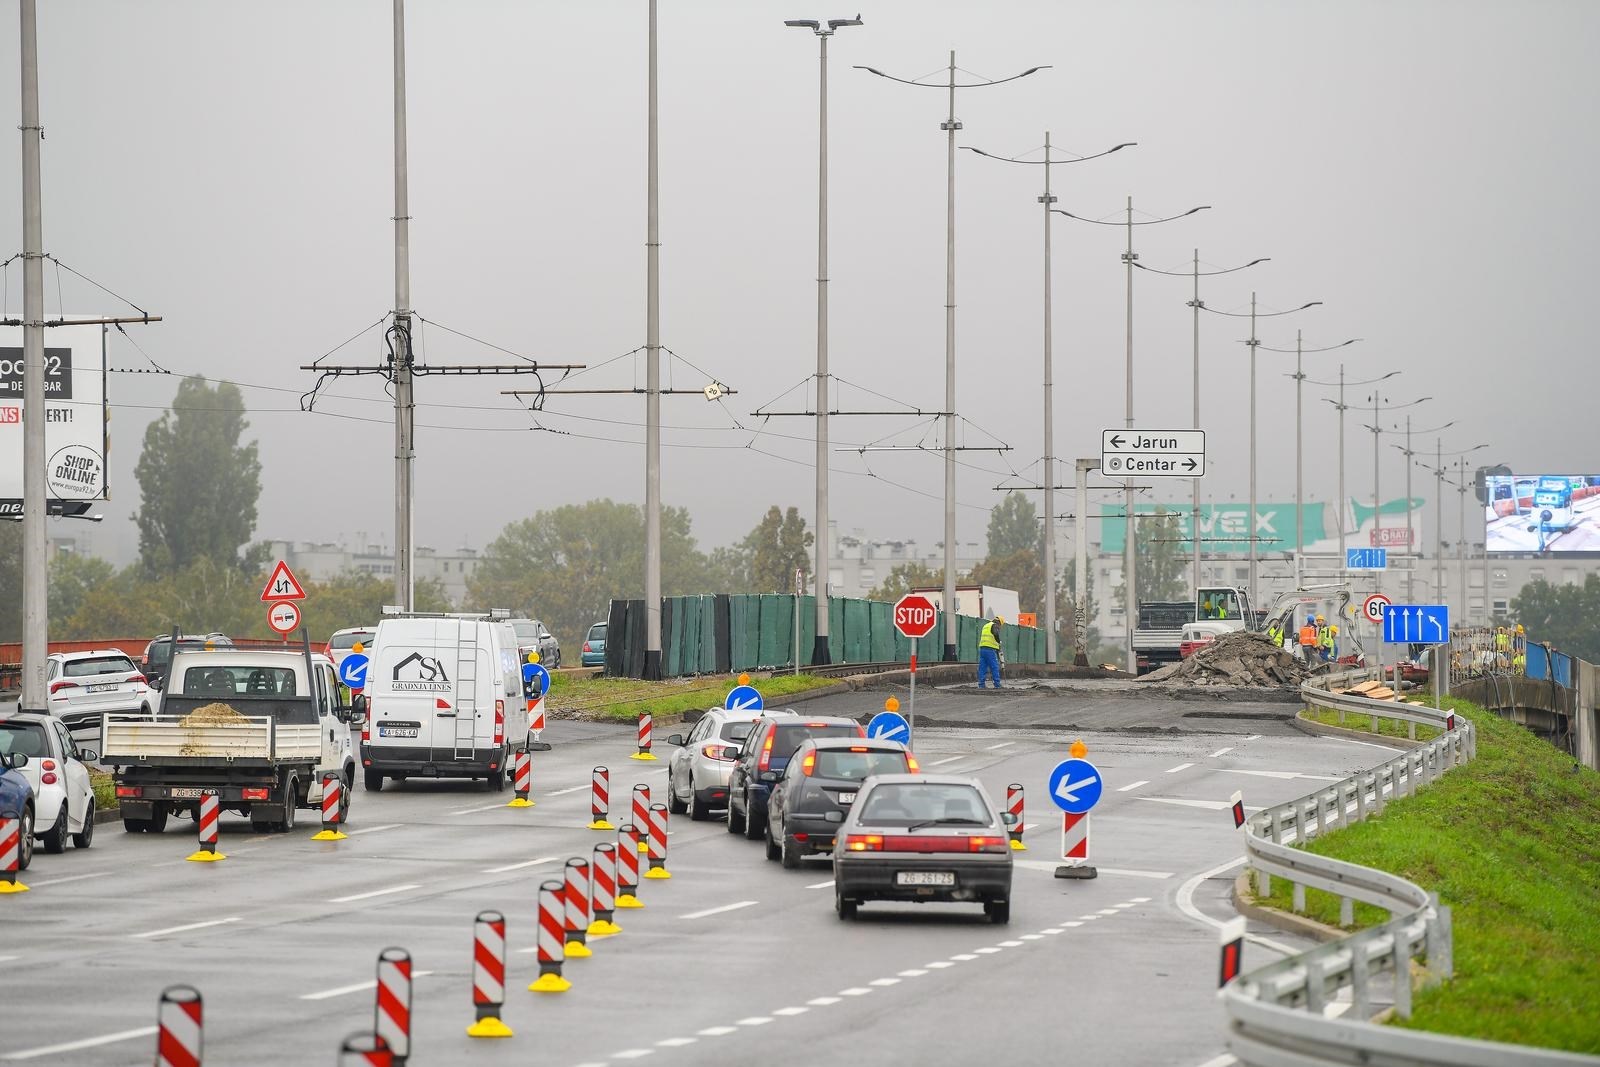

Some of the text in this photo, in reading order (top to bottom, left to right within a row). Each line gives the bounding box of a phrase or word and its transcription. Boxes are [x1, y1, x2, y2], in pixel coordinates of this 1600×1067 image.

[708, 387, 718, 395] 20
[0, 407, 17, 422] NS
[1132, 435, 1177, 448] Jarun
[64, 454, 94, 470] SHOP
[1126, 457, 1177, 470] Centar
[55, 465, 97, 485] ONLINE
[897, 607, 933, 625] STOP
[419, 656, 449, 681] SA
